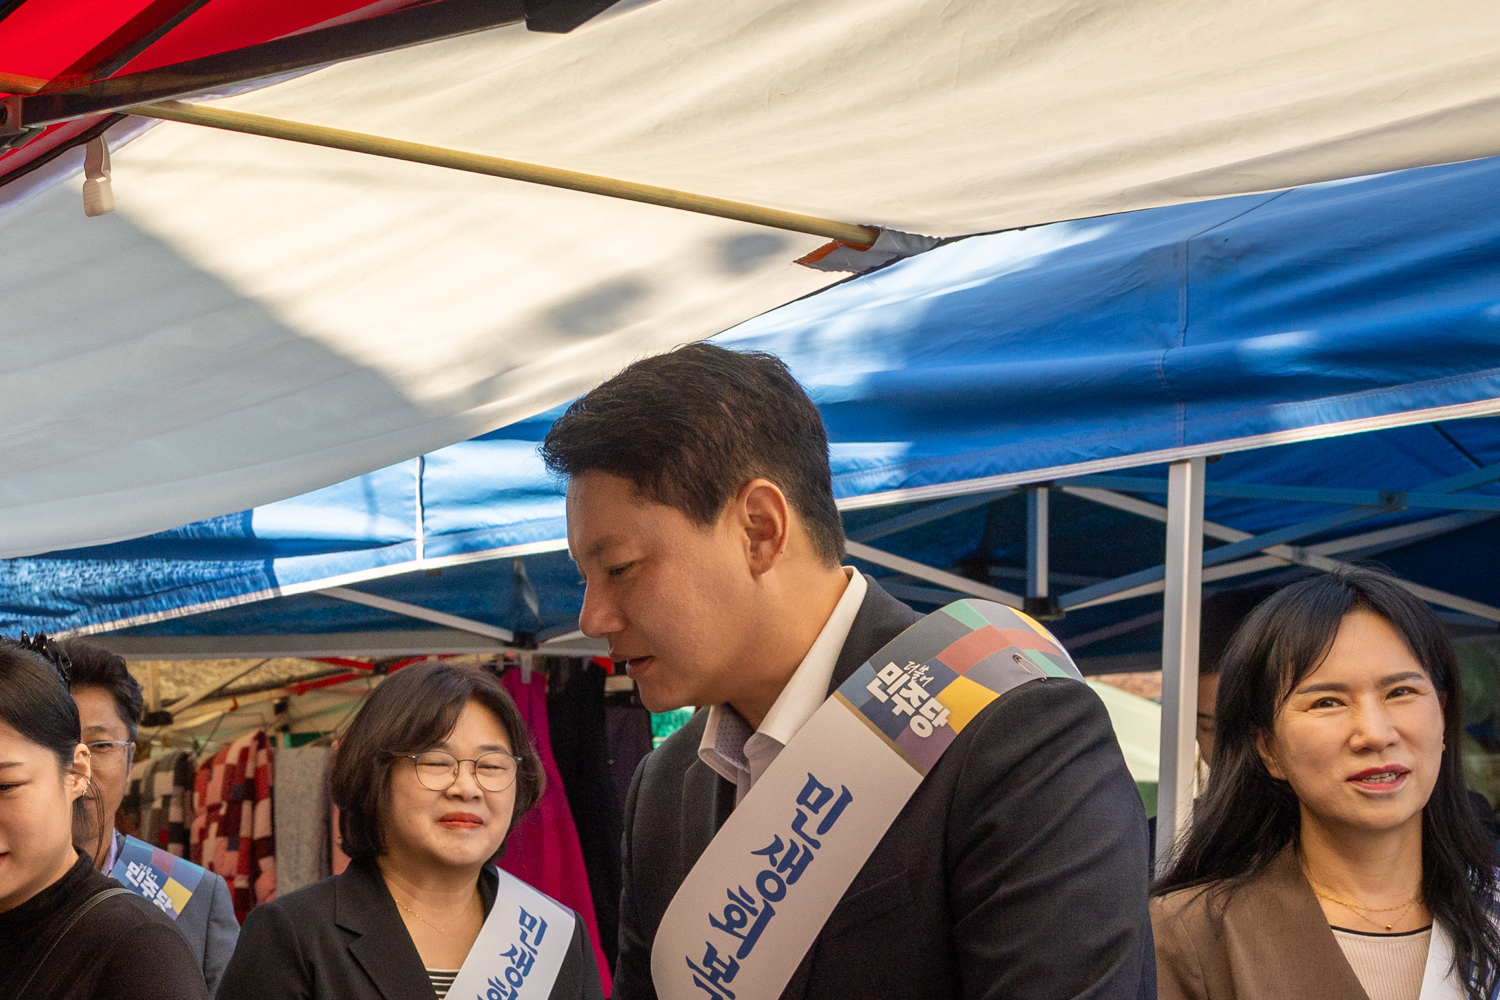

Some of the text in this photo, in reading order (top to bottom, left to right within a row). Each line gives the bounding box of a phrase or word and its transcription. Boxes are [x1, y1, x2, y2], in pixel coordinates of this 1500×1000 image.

[866, 661, 950, 738] 민주당
[903, 661, 934, 687] 더불어
[125, 861, 173, 912] 민주당
